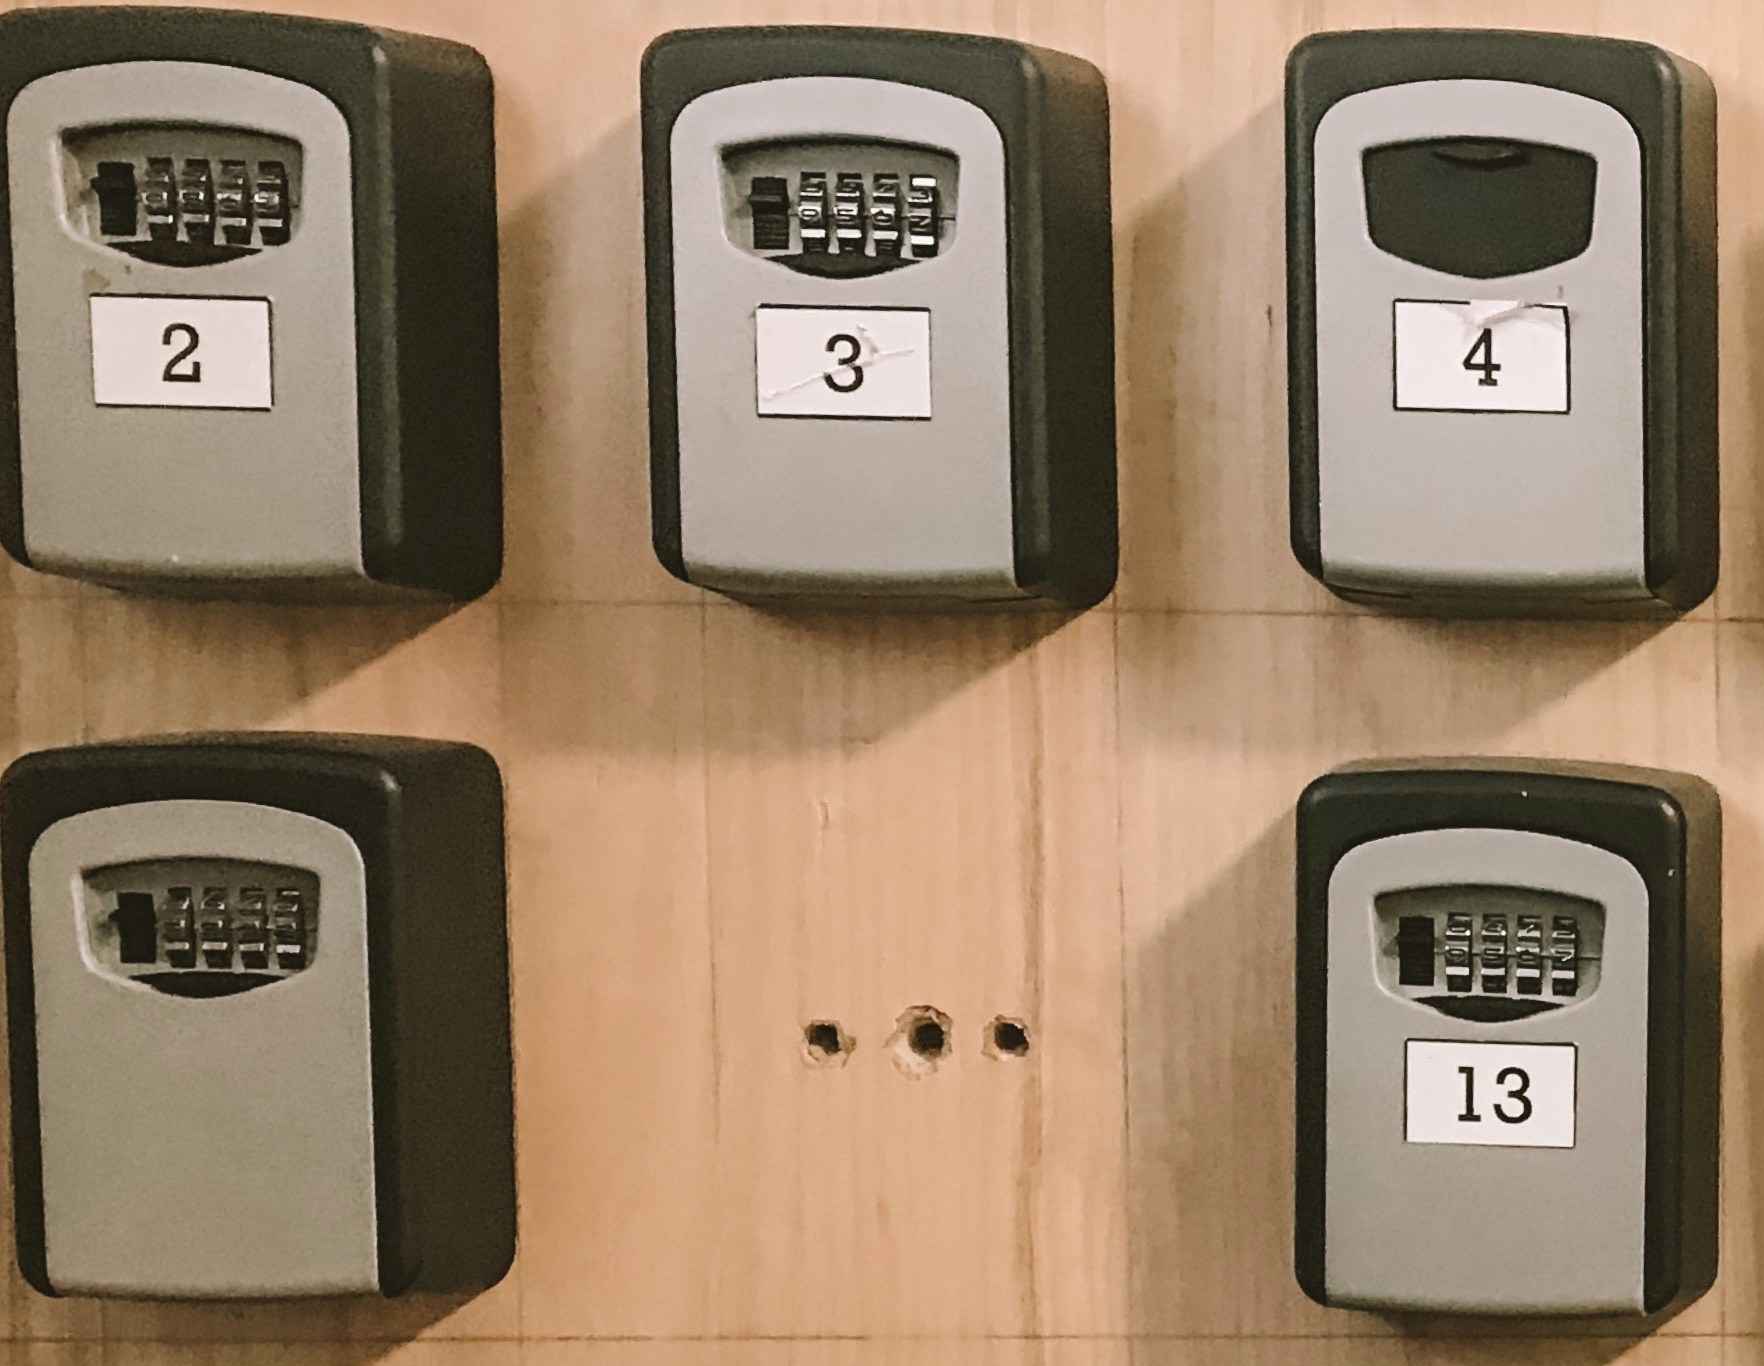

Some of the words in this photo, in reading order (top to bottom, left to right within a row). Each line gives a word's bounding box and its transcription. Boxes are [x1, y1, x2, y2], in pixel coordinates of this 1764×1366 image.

[162, 323, 202, 383] 2
[823, 333, 864, 393] 3
[1462, 329, 1502, 387] 4
[1457, 1066, 1533, 1124] 13
